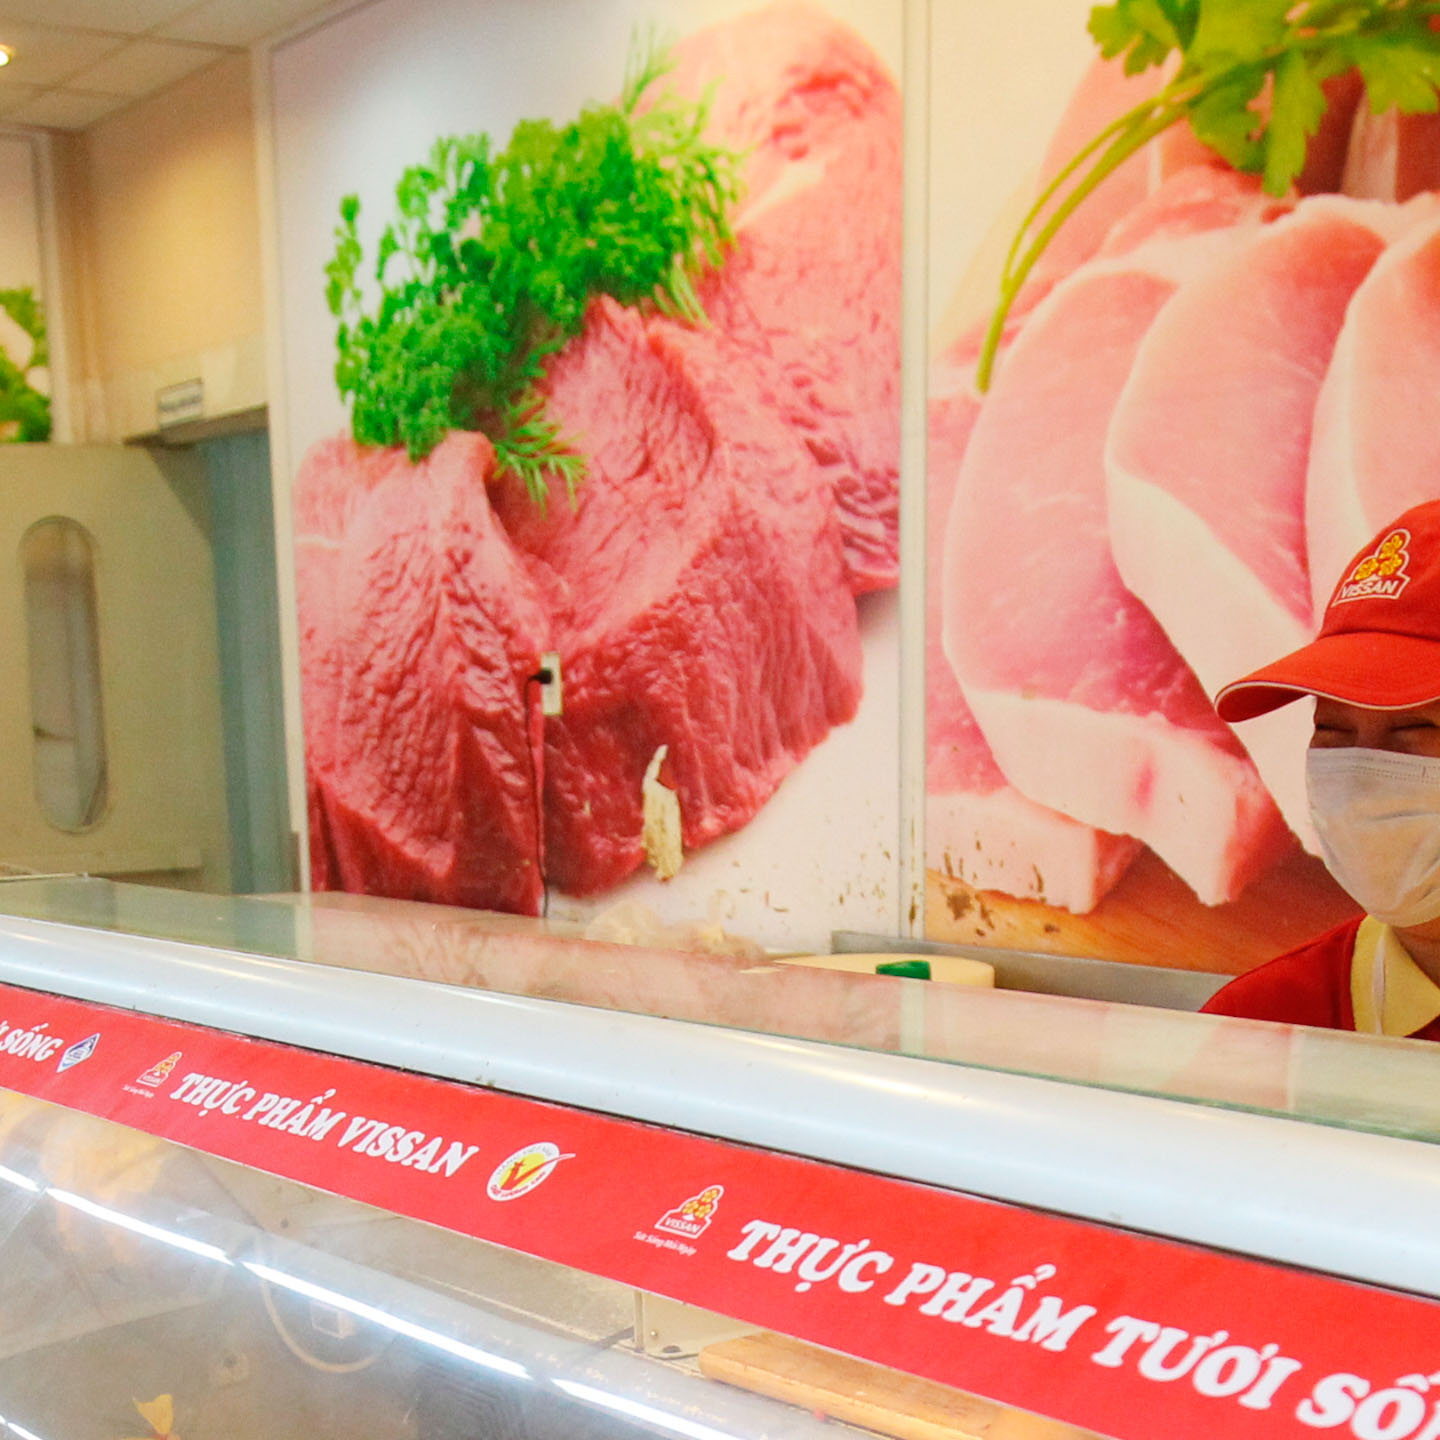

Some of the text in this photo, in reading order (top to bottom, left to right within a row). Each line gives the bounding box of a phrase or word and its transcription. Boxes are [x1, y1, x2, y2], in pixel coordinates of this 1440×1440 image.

[1341, 580, 1399, 598] VISSAN
[169, 1073, 256, 1117] THỰC
[242, 1088, 347, 1141] PHẨM
[337, 1117, 480, 1177] VISSAN
[665, 1217, 701, 1233] VISSAN
[727, 1219, 894, 1293] THỰC
[884, 1263, 1096, 1352] PHẨM
[1091, 1315, 1302, 1410] TƯƠI
